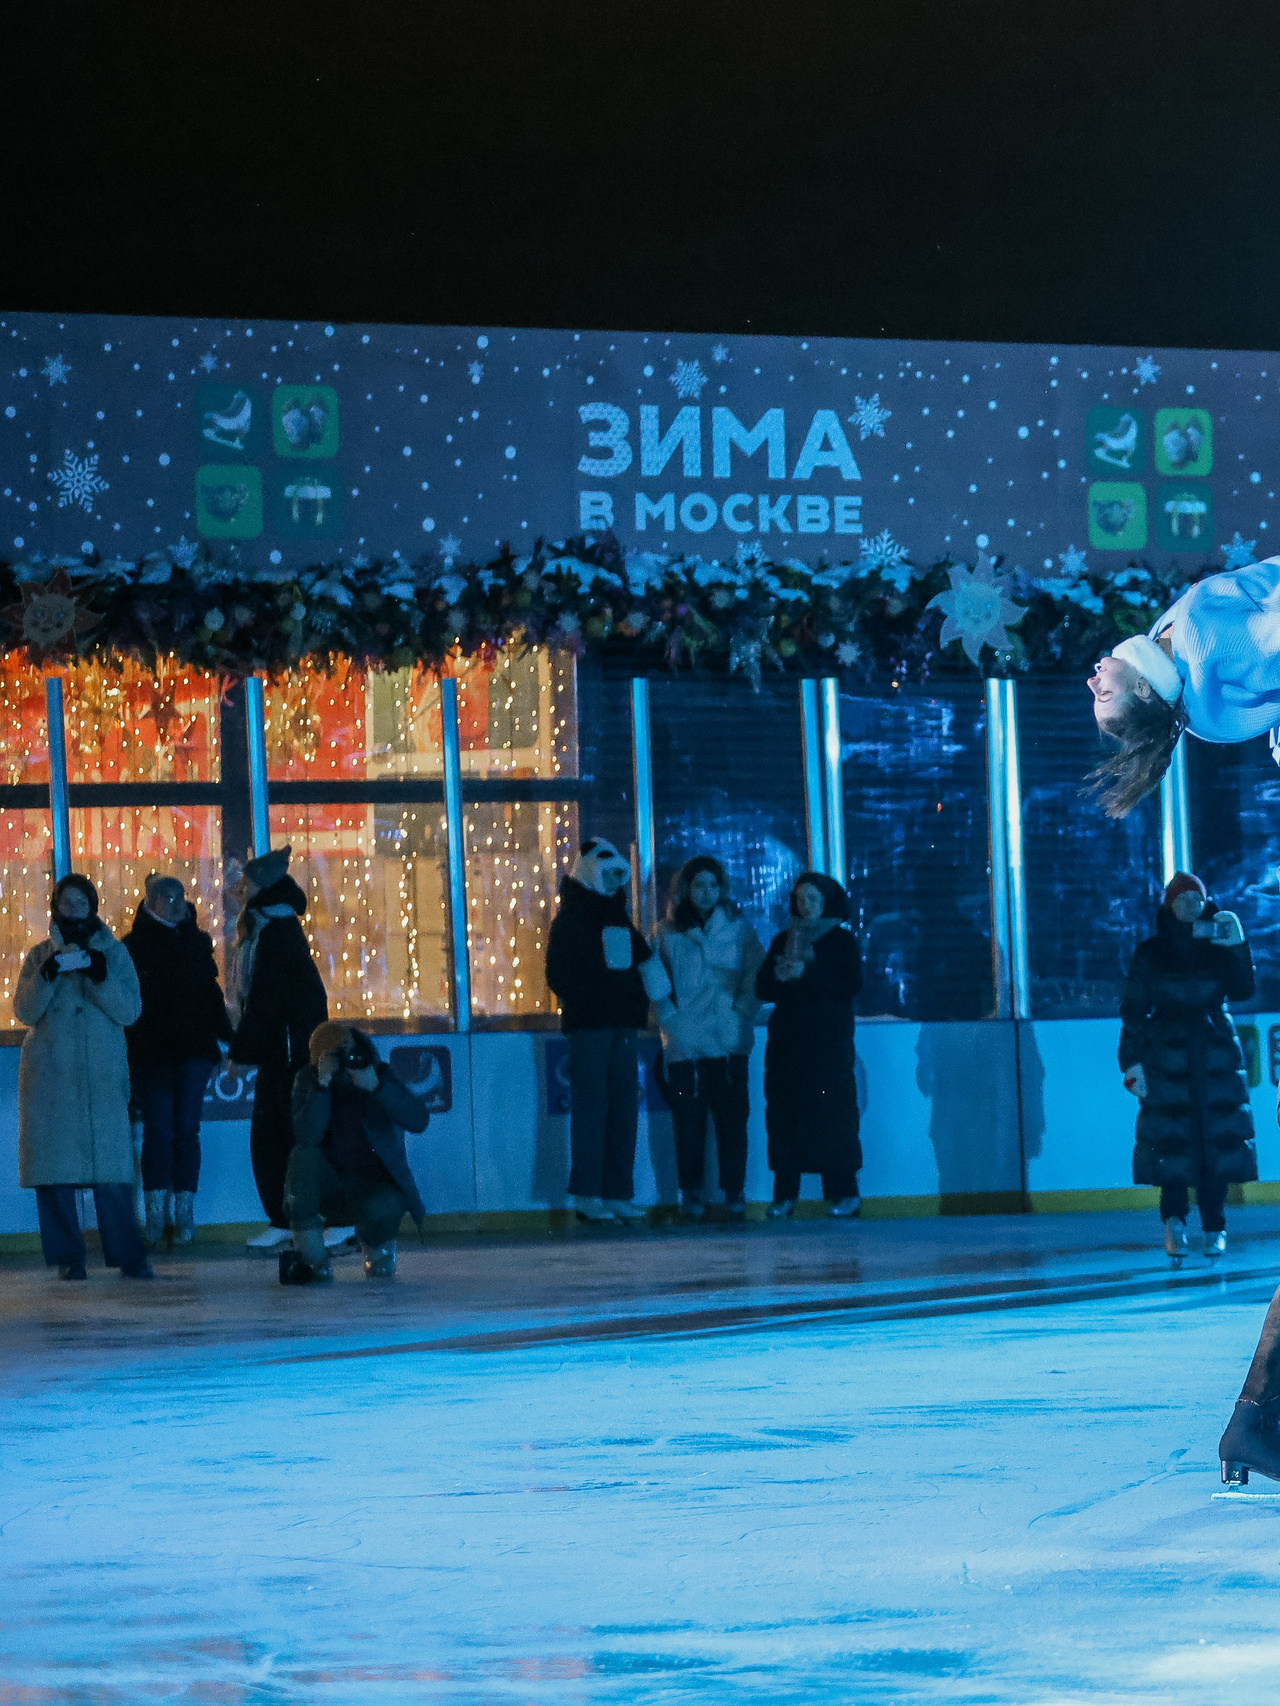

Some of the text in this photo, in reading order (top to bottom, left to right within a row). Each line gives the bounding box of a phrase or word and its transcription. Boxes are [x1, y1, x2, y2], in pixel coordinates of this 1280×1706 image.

[577, 402, 863, 480] ЗИМА
[579, 491, 863, 534] В МОСКВЕ
